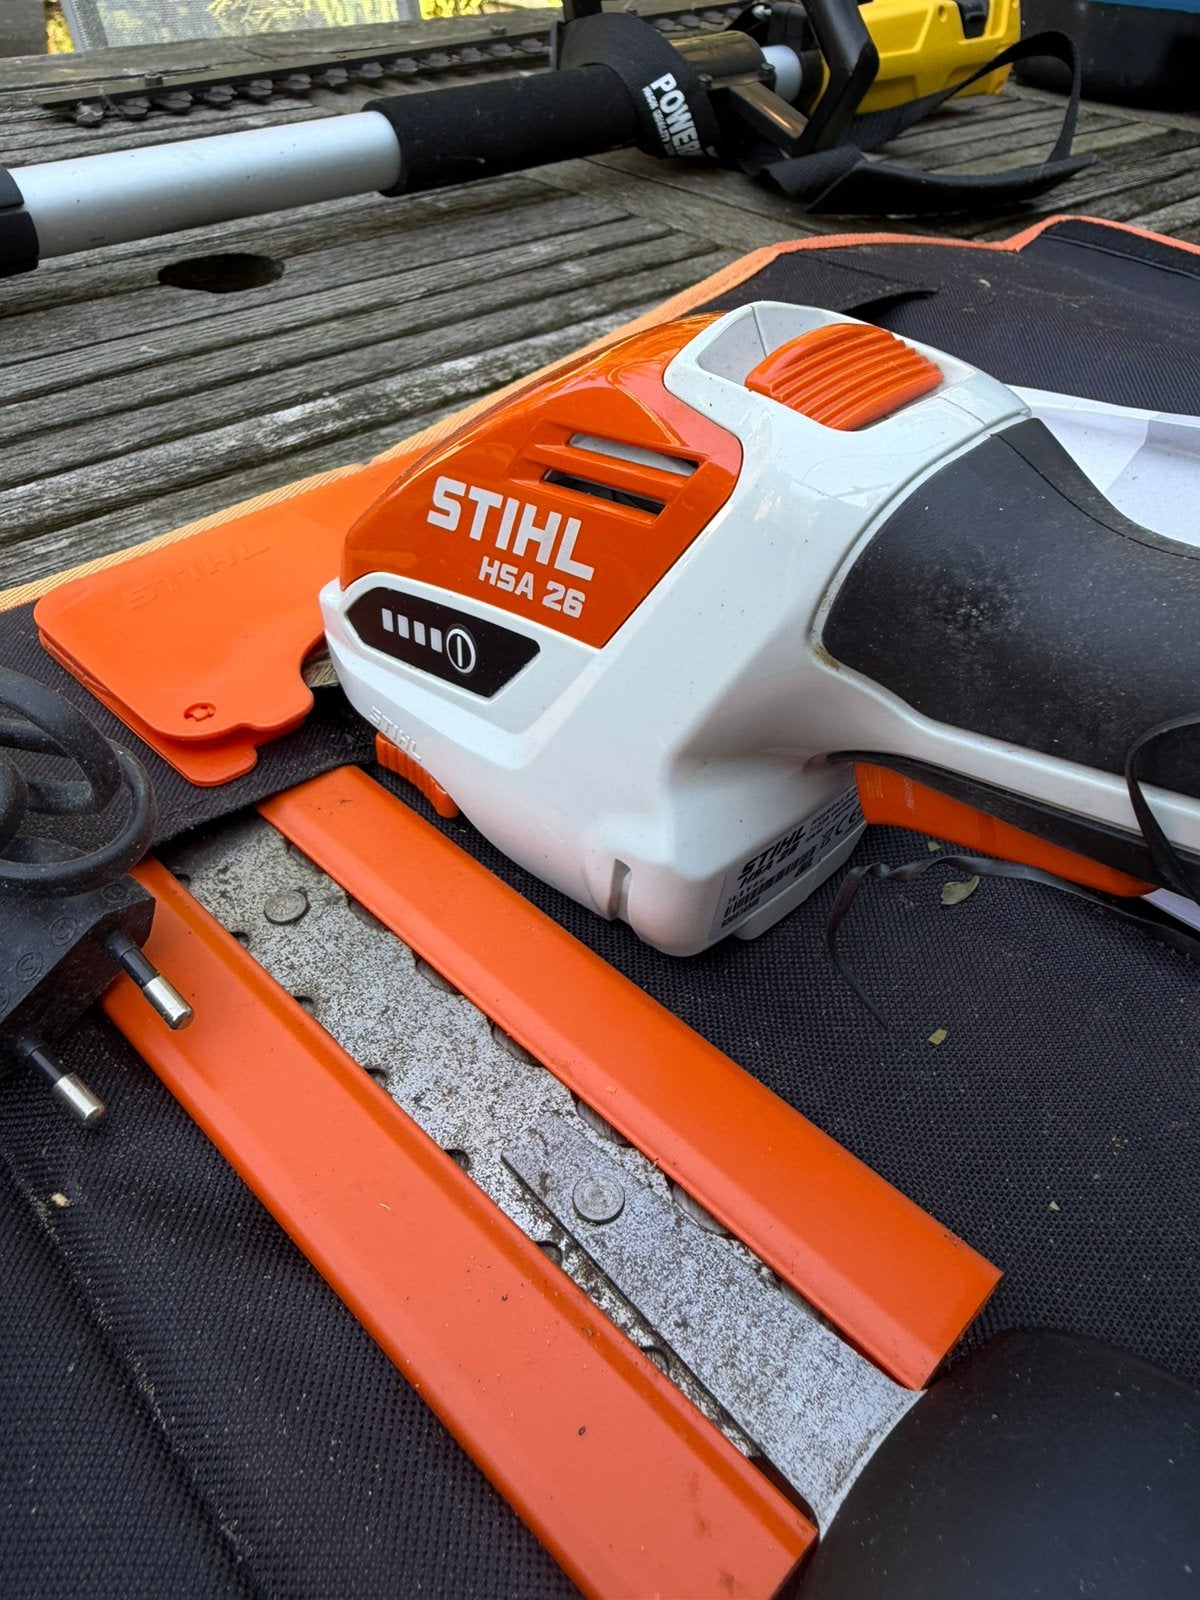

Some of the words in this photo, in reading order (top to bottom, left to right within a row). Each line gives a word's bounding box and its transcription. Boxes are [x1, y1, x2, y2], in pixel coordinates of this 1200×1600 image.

[427, 475, 595, 582] STIHL
[126, 543, 271, 611] STIHL
[478, 555, 534, 601] HSA
[541, 580, 586, 619] 26
[369, 705, 422, 761] STIHL
[737, 825, 806, 881] STIHL
